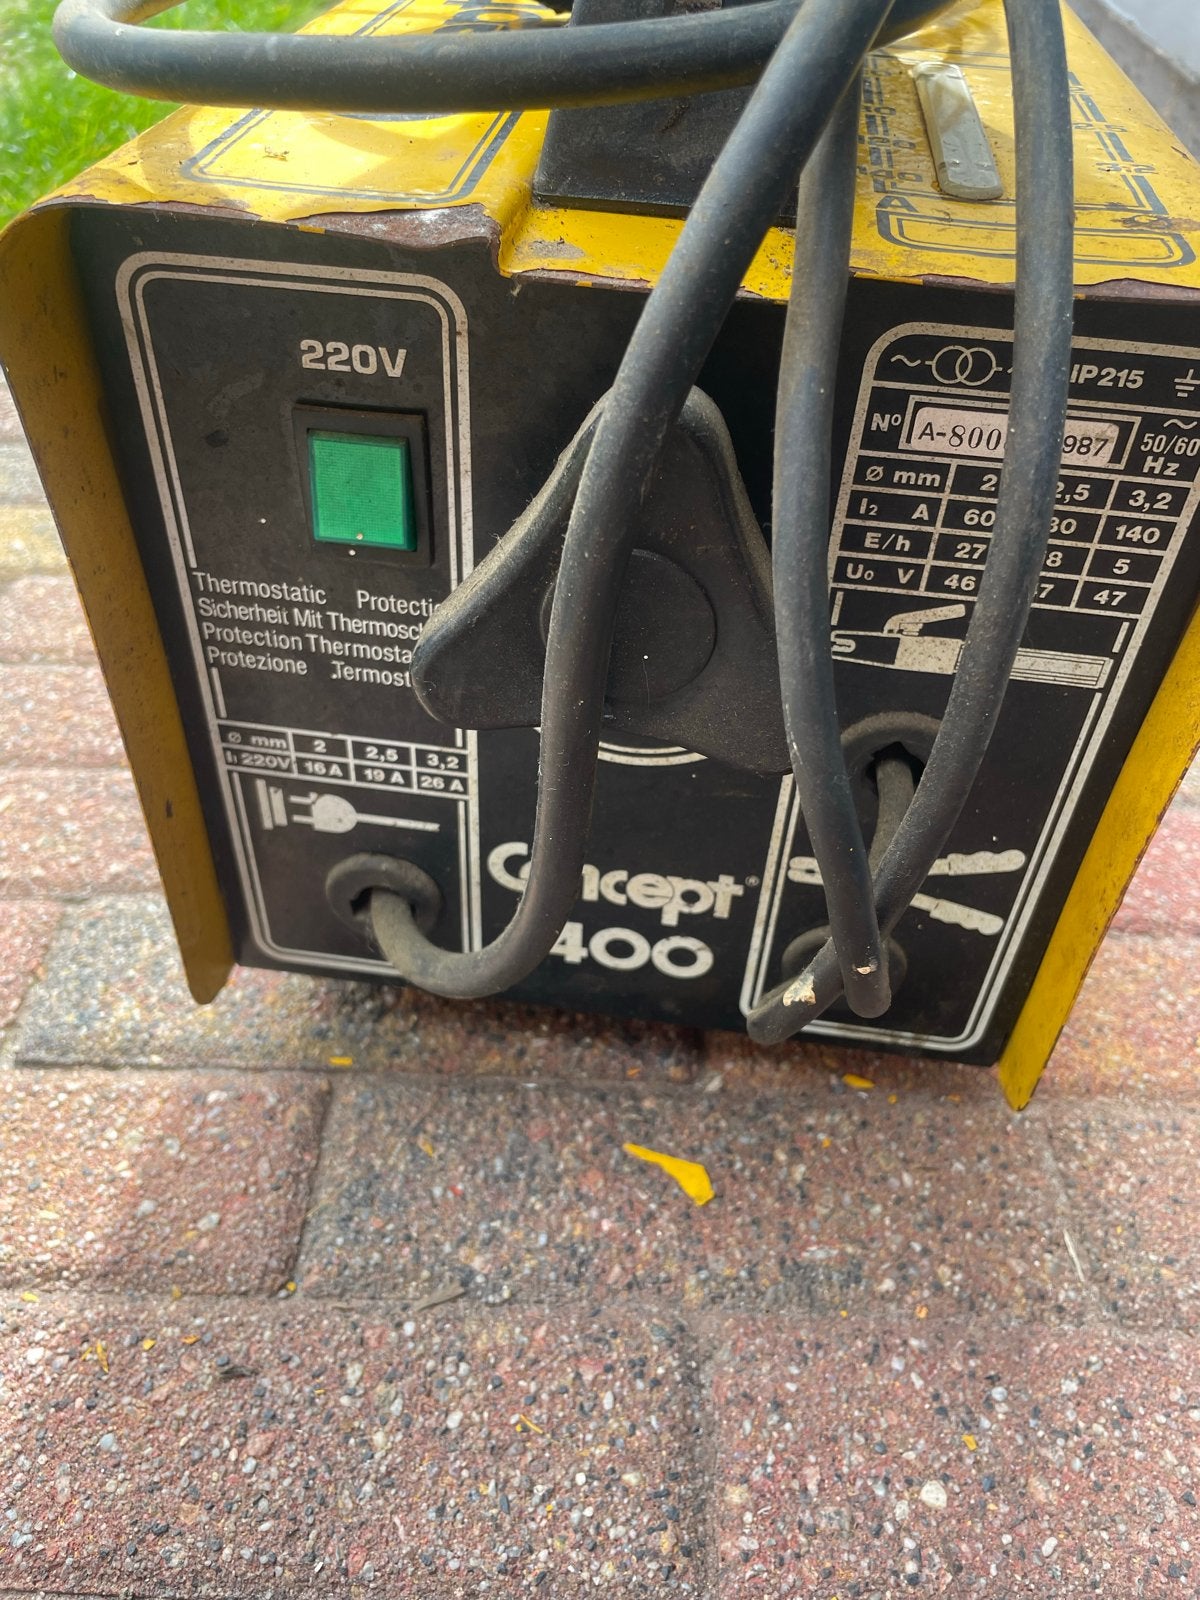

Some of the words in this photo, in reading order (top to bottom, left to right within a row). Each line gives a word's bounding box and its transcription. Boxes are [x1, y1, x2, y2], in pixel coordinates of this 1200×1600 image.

[300, 339, 407, 378] 220V
[1069, 363, 1145, 389] IP215
[918, 422, 1008, 451] A-800
[1140, 433, 1200, 457] 50/60
[1142, 455, 1180, 477] Hz
[893, 470, 941, 488] mm
[979, 474, 998, 492] 2
[1128, 489, 1172, 512] 3,2
[911, 503, 930, 521] A
[963, 508, 996, 527] 60
[1115, 524, 1161, 544] 140
[863, 532, 911, 552] E/h
[954, 542, 987, 559] 27
[1112, 558, 1131, 574] 5
[192, 570, 327, 606] Thermostatic
[897, 568, 915, 584] V
[943, 574, 977, 591] 46
[1093, 590, 1127, 606] 47
[197, 597, 289, 630] Sicherheit
[293, 607, 324, 632] Mit
[202, 621, 302, 652] Protection
[207, 645, 308, 676] Protezione
[250, 736, 288, 750] mm
[313, 740, 327, 754] 2
[365, 745, 399, 763] 2,5
[426, 753, 460, 771] 3,2
[241, 752, 291, 771] 220V
[304, 760, 327, 776] 16
[328, 762, 344, 778] A
[363, 768, 386, 783] 19
[389, 770, 406, 786] A
[420, 775, 446, 791] 26
[448, 779, 465, 793] A
[550, 921, 714, 979] 400
